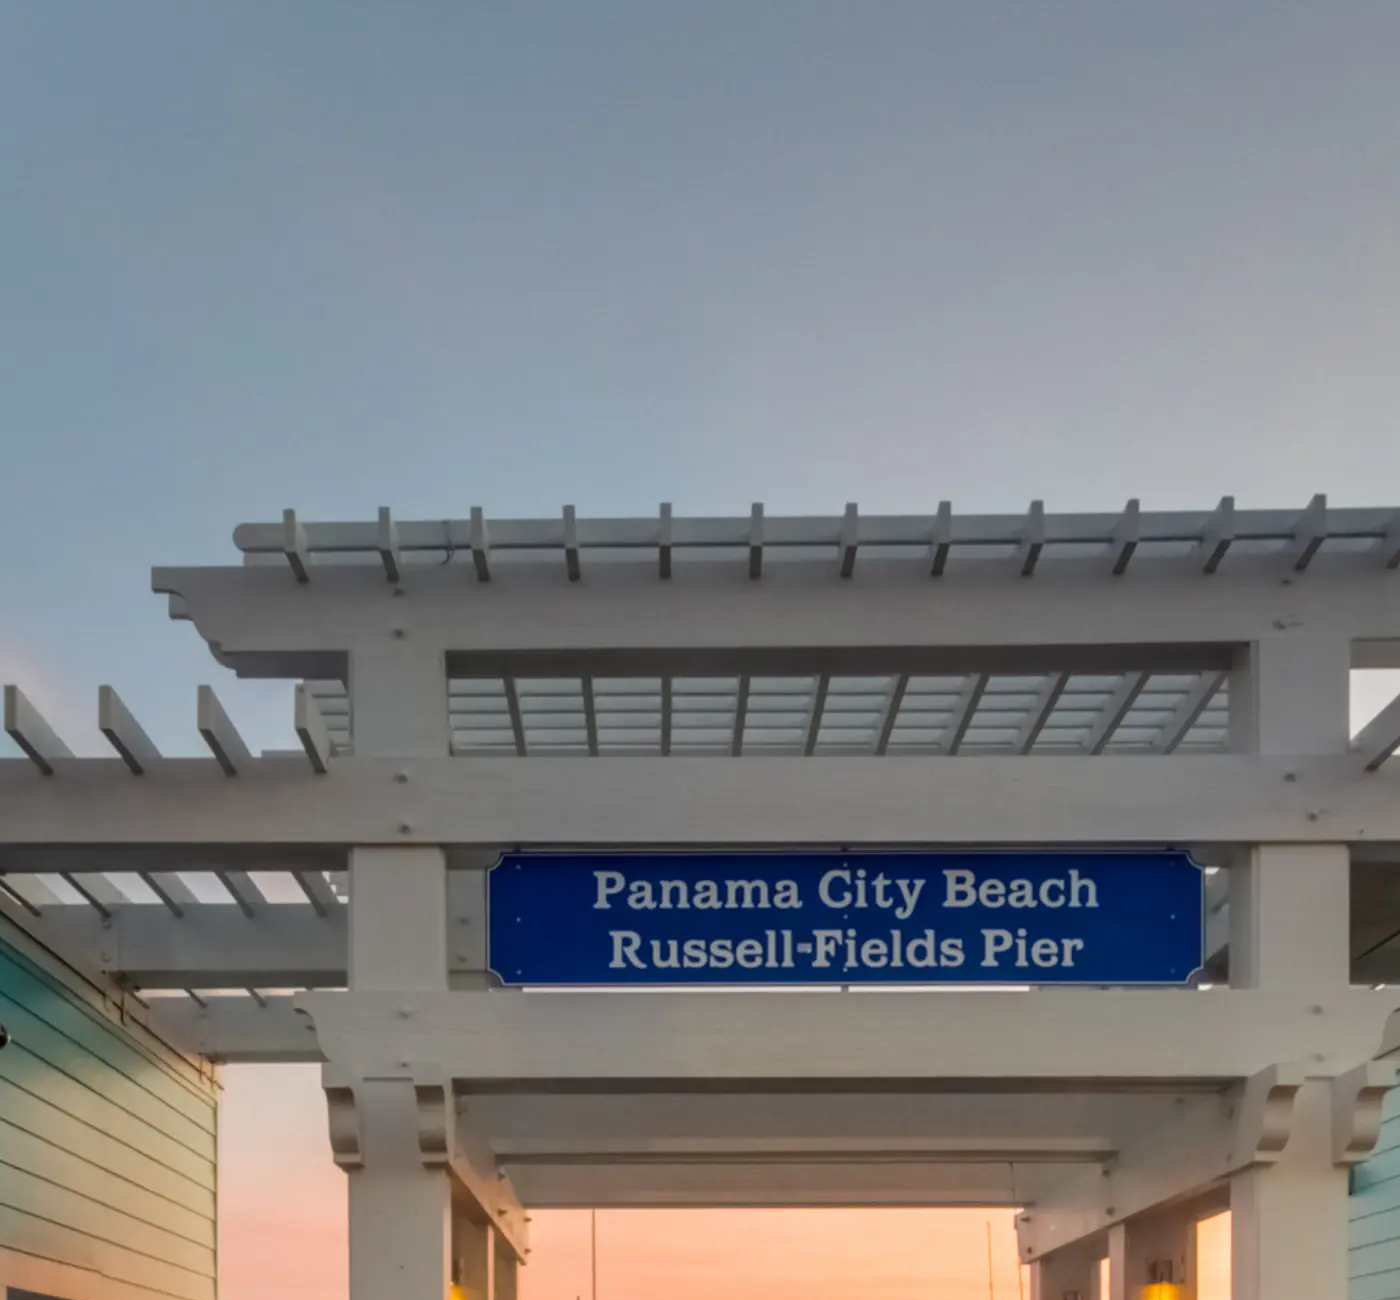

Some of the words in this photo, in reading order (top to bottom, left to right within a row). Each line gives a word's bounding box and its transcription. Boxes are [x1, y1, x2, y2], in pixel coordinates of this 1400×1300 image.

[593, 870, 803, 910] Panama
[818, 869, 926, 919] City
[942, 869, 1099, 909] Beach
[609, 928, 965, 970] Russell-Fields
[981, 929, 1084, 967] Pier
